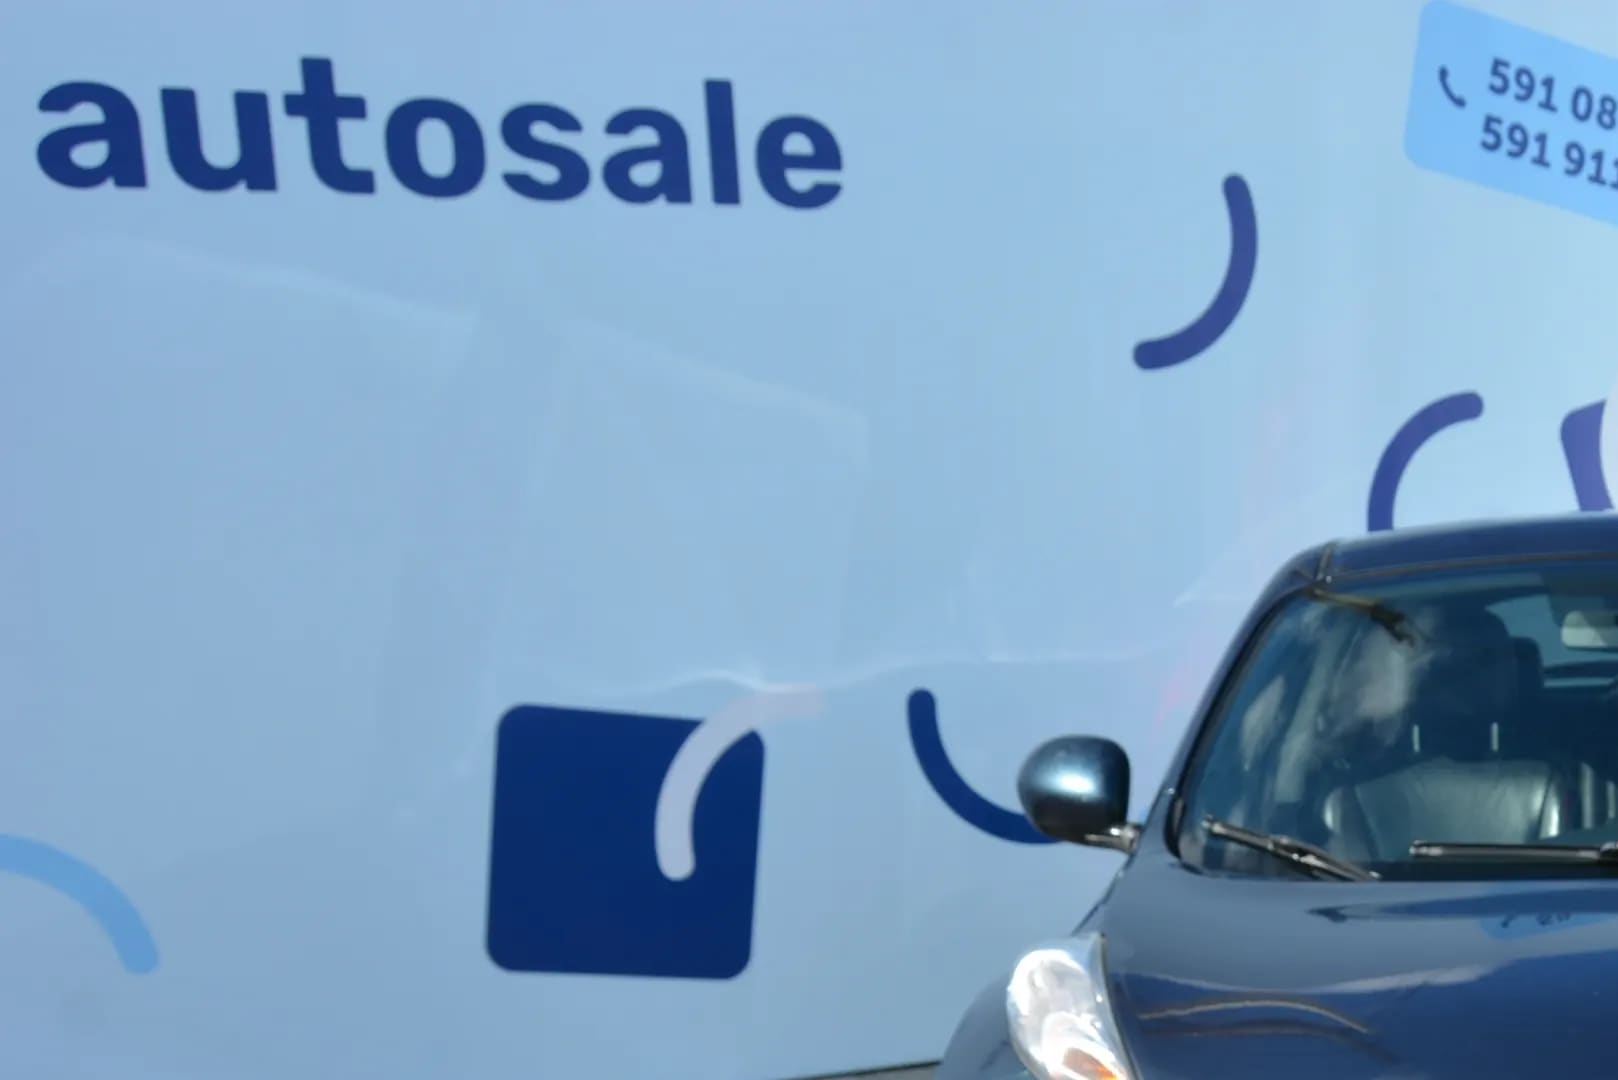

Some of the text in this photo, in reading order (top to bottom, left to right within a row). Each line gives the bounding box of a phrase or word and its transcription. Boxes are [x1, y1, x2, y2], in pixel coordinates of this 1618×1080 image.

[1488, 57, 1558, 112] 591
[36, 57, 843, 209] autosale
[1480, 114, 1551, 168] 591
